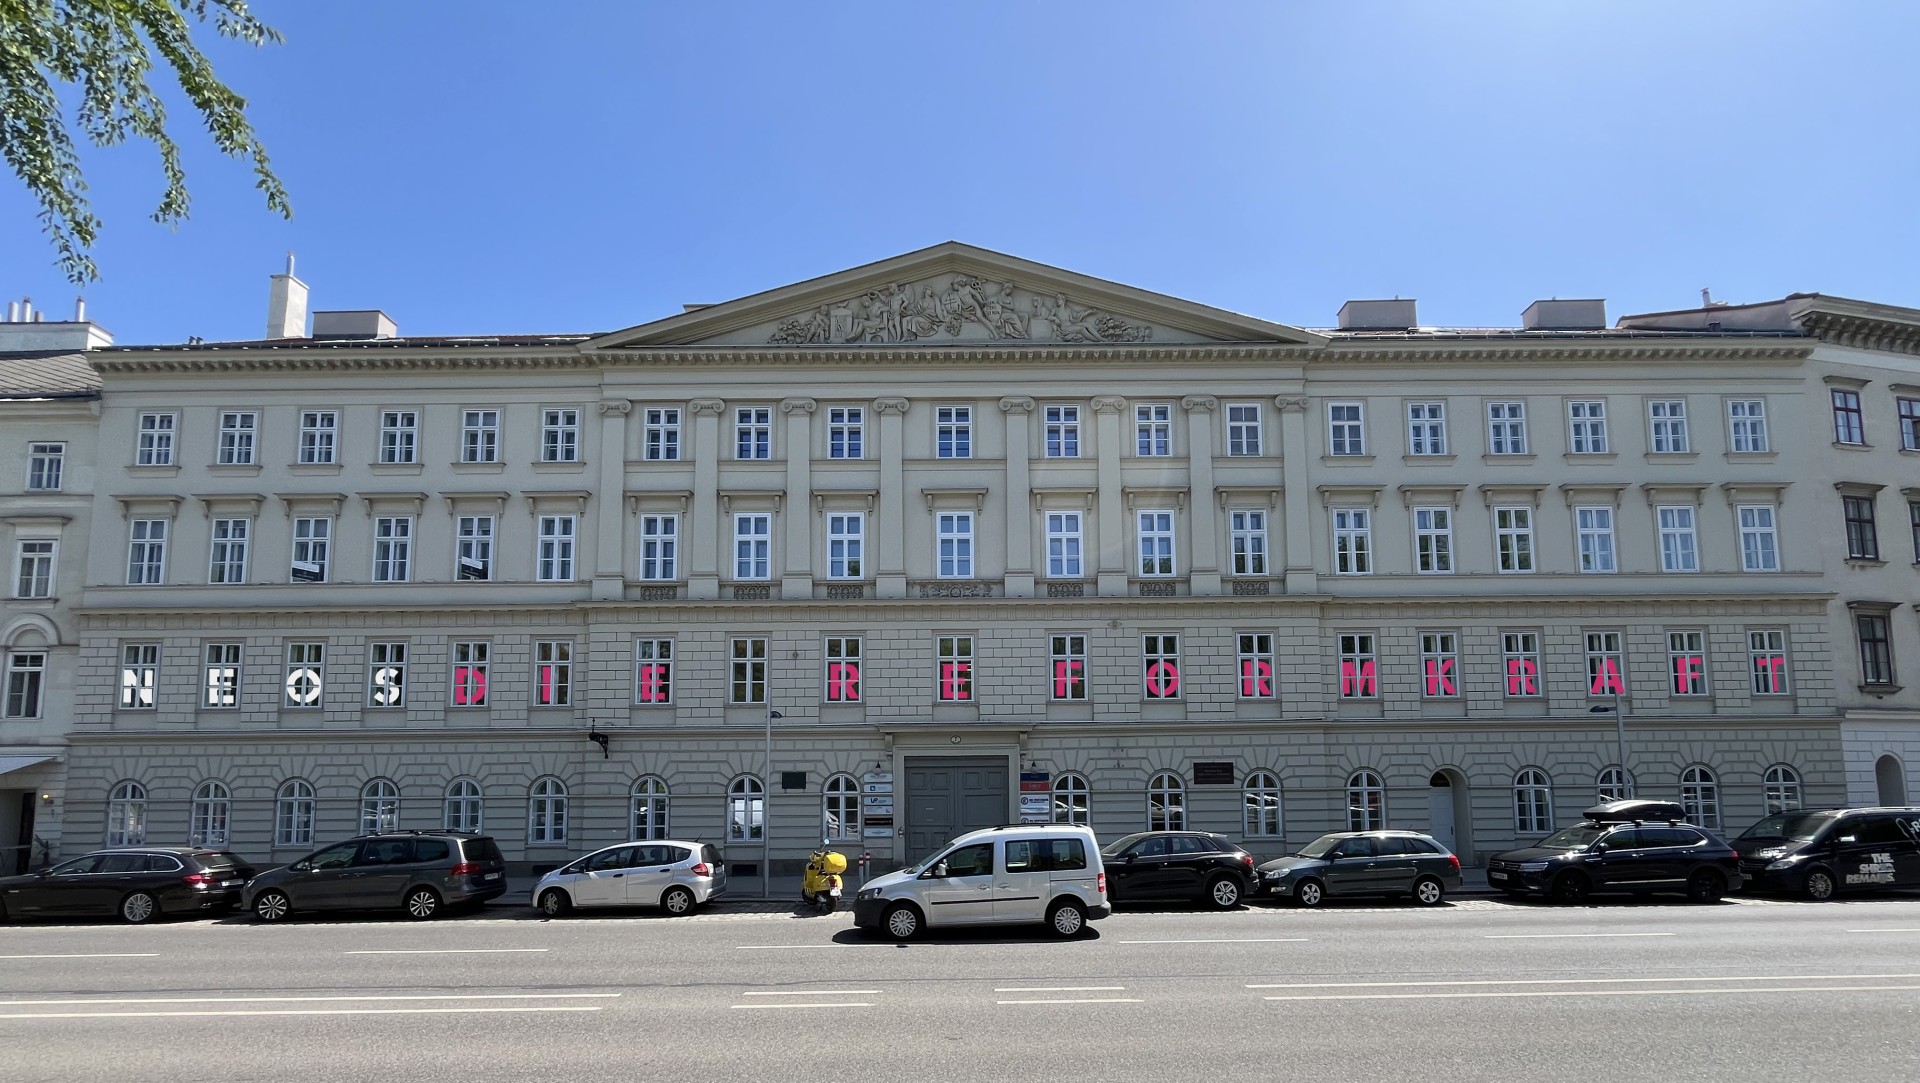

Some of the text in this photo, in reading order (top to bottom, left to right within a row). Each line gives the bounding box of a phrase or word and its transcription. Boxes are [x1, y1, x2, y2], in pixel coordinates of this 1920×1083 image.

[122, 657, 1785, 704] NEOS DIE REFORMKRAFT
[1870, 852, 1895, 864] THE
